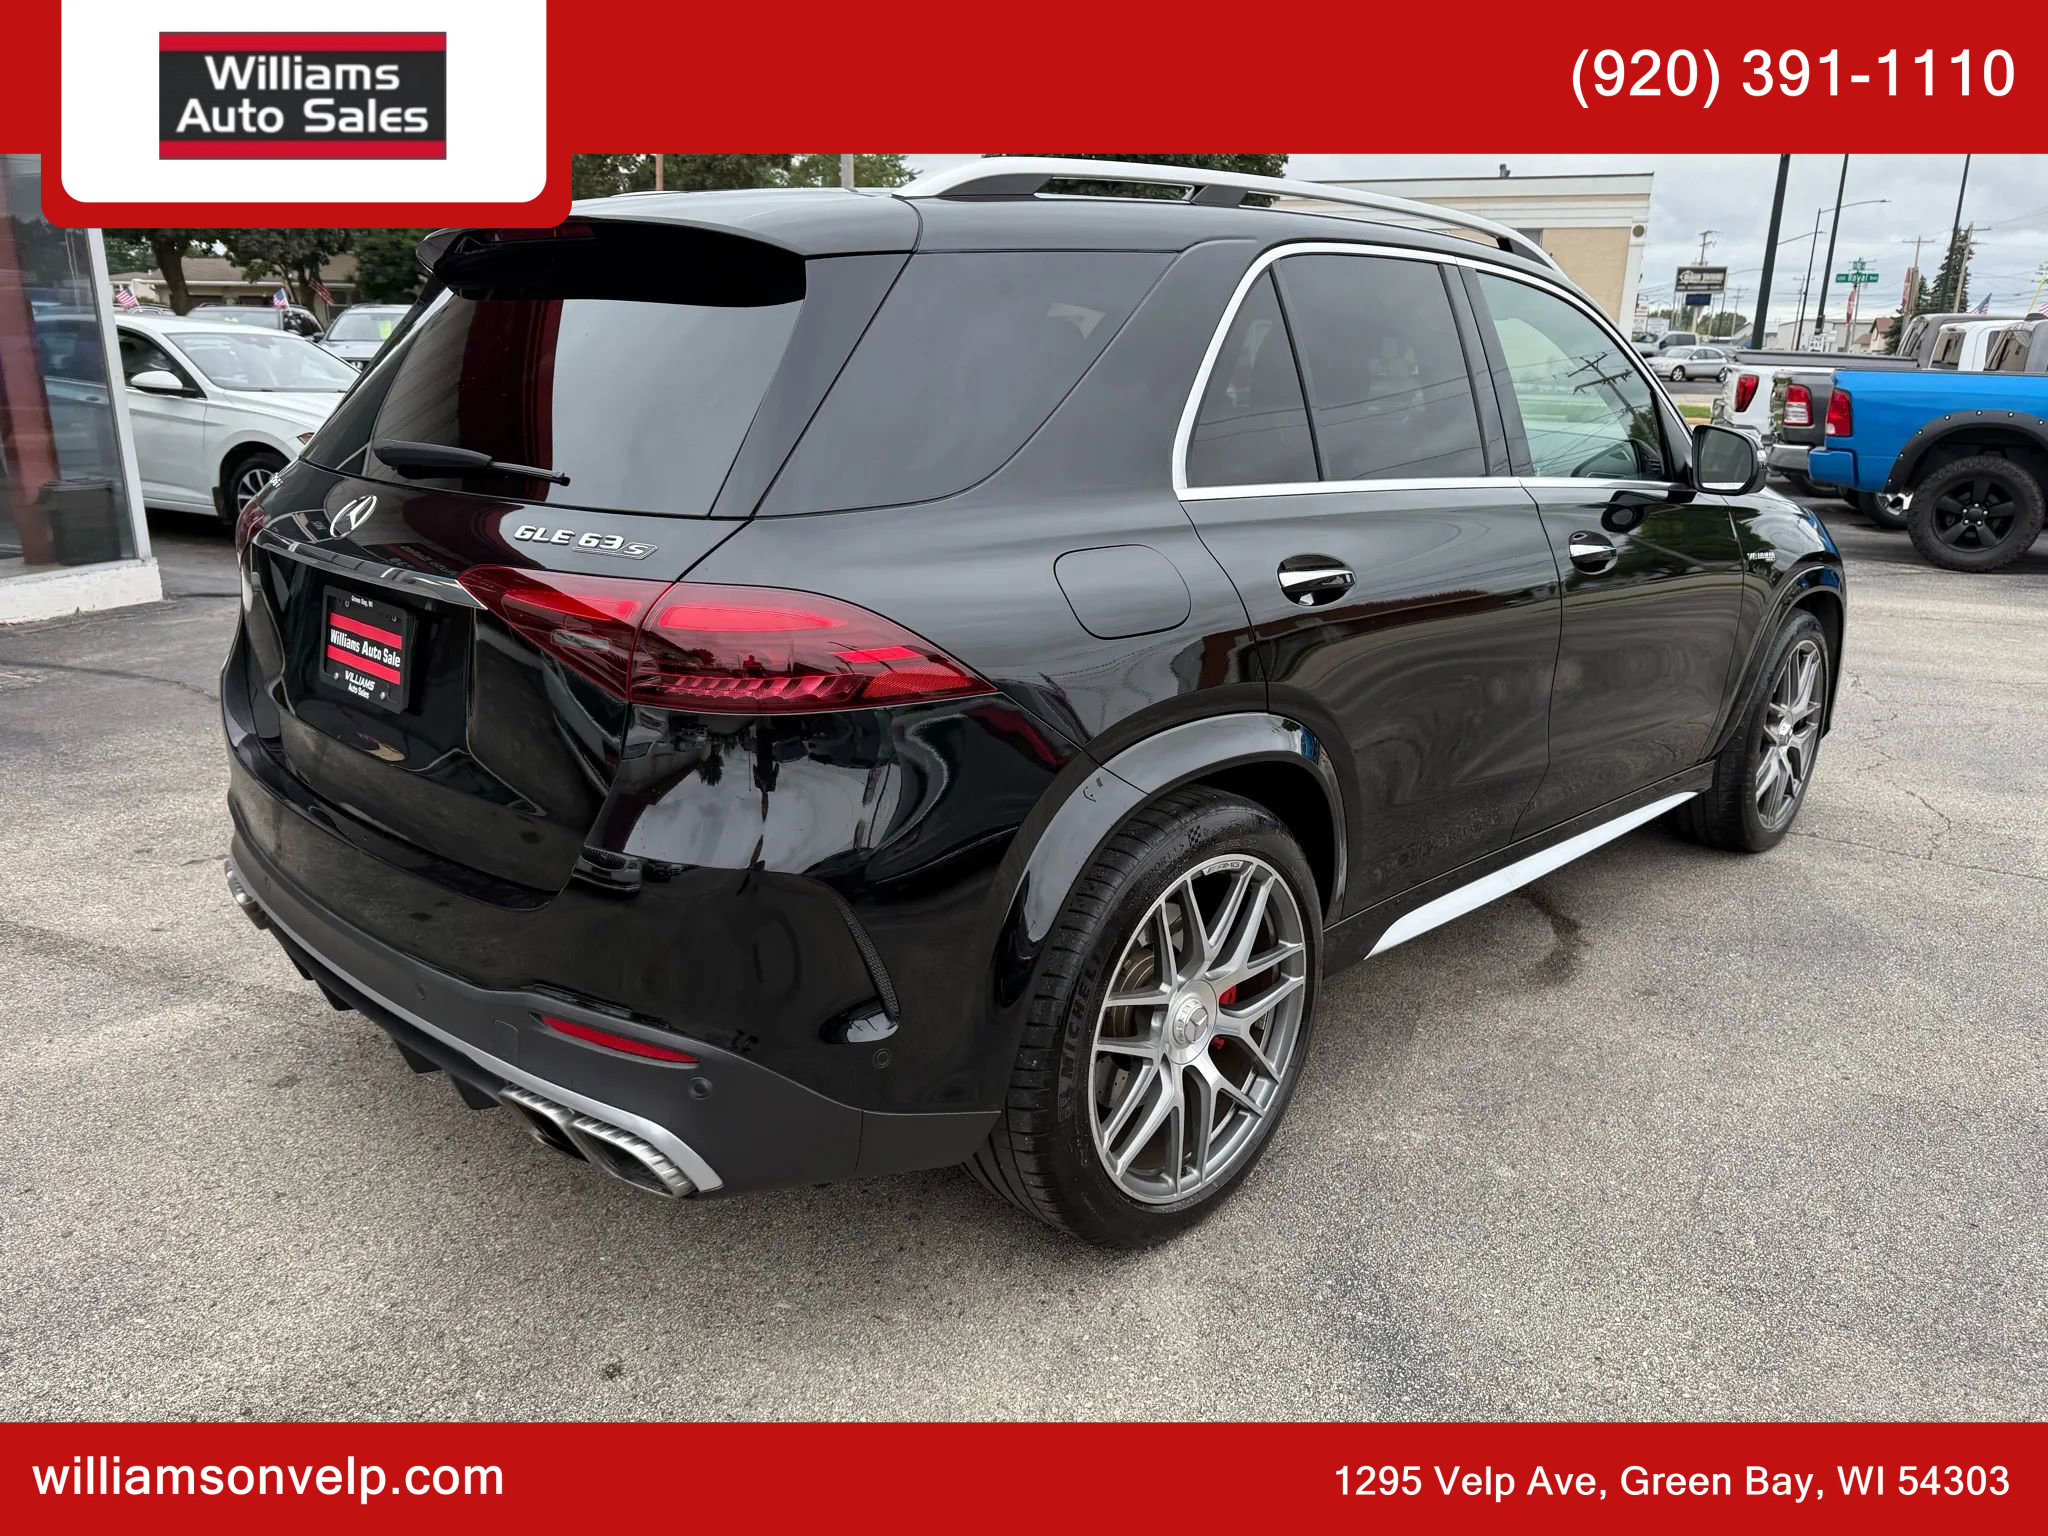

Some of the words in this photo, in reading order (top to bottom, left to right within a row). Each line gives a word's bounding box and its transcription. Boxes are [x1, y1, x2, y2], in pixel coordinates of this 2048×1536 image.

[1848, 273, 1868, 282] Royal
[514, 525, 575, 544] GLE
[330, 628, 361, 653] Williams
[361, 640, 382, 661] Auto
[382, 647, 401, 668] Sale
[344, 670, 376, 691] WILLIAMS
[348, 683, 359, 696] Auto
[358, 687, 370, 699] Sales
[1060, 934, 1108, 1080] MICHELI
